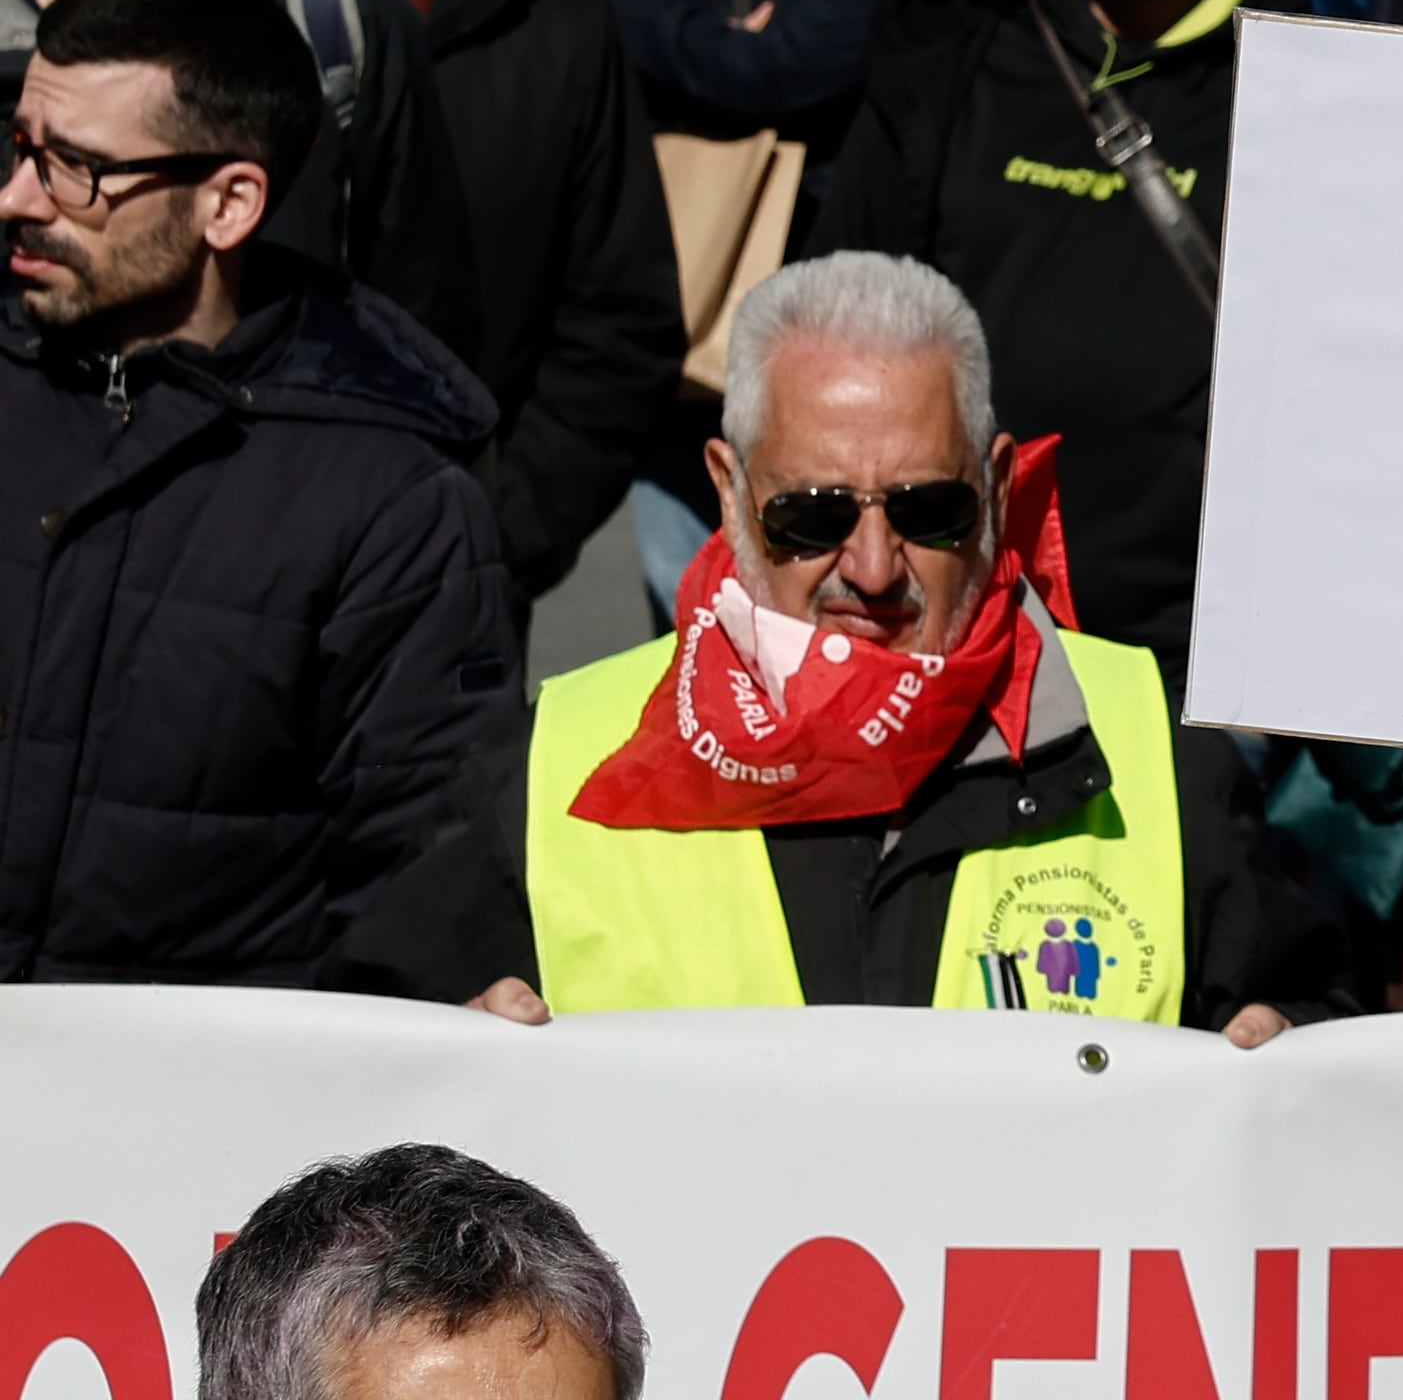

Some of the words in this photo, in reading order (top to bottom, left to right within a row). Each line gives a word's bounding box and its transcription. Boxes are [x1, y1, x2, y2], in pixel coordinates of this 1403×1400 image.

[677, 605, 718, 741] Pensiones
[856, 652, 946, 747] Parla
[692, 730, 798, 785] Dignas
[1013, 863, 1128, 916] Pensionistas
[1127, 917, 1146, 941] de
[1137, 944, 1155, 995] Parla
[1016, 903, 1112, 922] PENSIONISTAS
